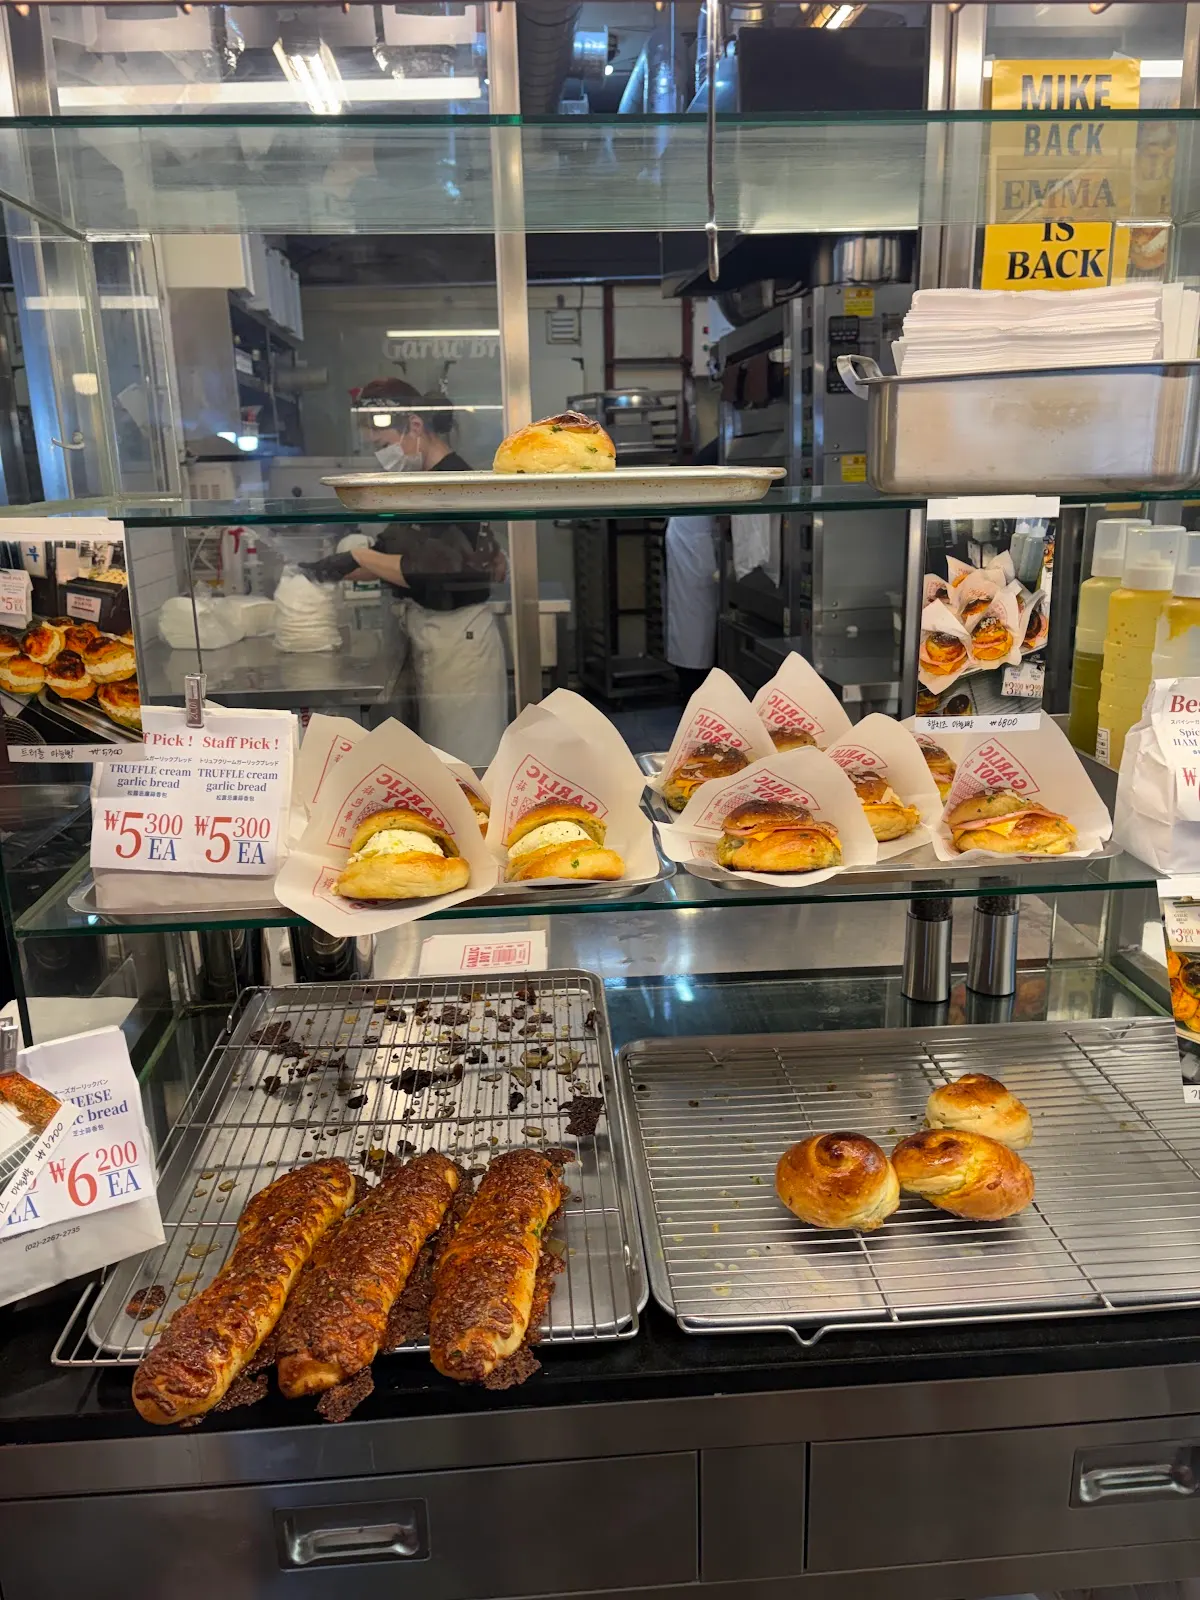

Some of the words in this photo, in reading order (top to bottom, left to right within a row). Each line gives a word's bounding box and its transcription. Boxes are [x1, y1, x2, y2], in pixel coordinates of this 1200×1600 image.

[1020, 73, 1113, 111] MIKE
[1023, 122, 1105, 157] BACK
[1002, 178, 1116, 210] EMMA
[1041, 217, 1074, 242] IS
[1005, 248, 1106, 281] BACK
[1169, 694, 1200, 713] Be
[152, 732, 185, 747] Pick
[202, 735, 238, 749] Staff
[240, 737, 270, 750] Pick
[109, 763, 157, 775] TRUFFLE
[159, 768, 191, 777] cream
[197, 768, 245, 779] TRUFFLE
[246, 771, 278, 780] cream
[117, 777, 148, 788] garlic
[149, 778, 180, 788] bread
[205, 781, 236, 792] garlic
[237, 781, 267, 792] bread
[148, 837, 177, 861] EA
[236, 841, 266, 865] EA
[87, 1099, 129, 1122] bread
[105, 1168, 142, 1198] EA
